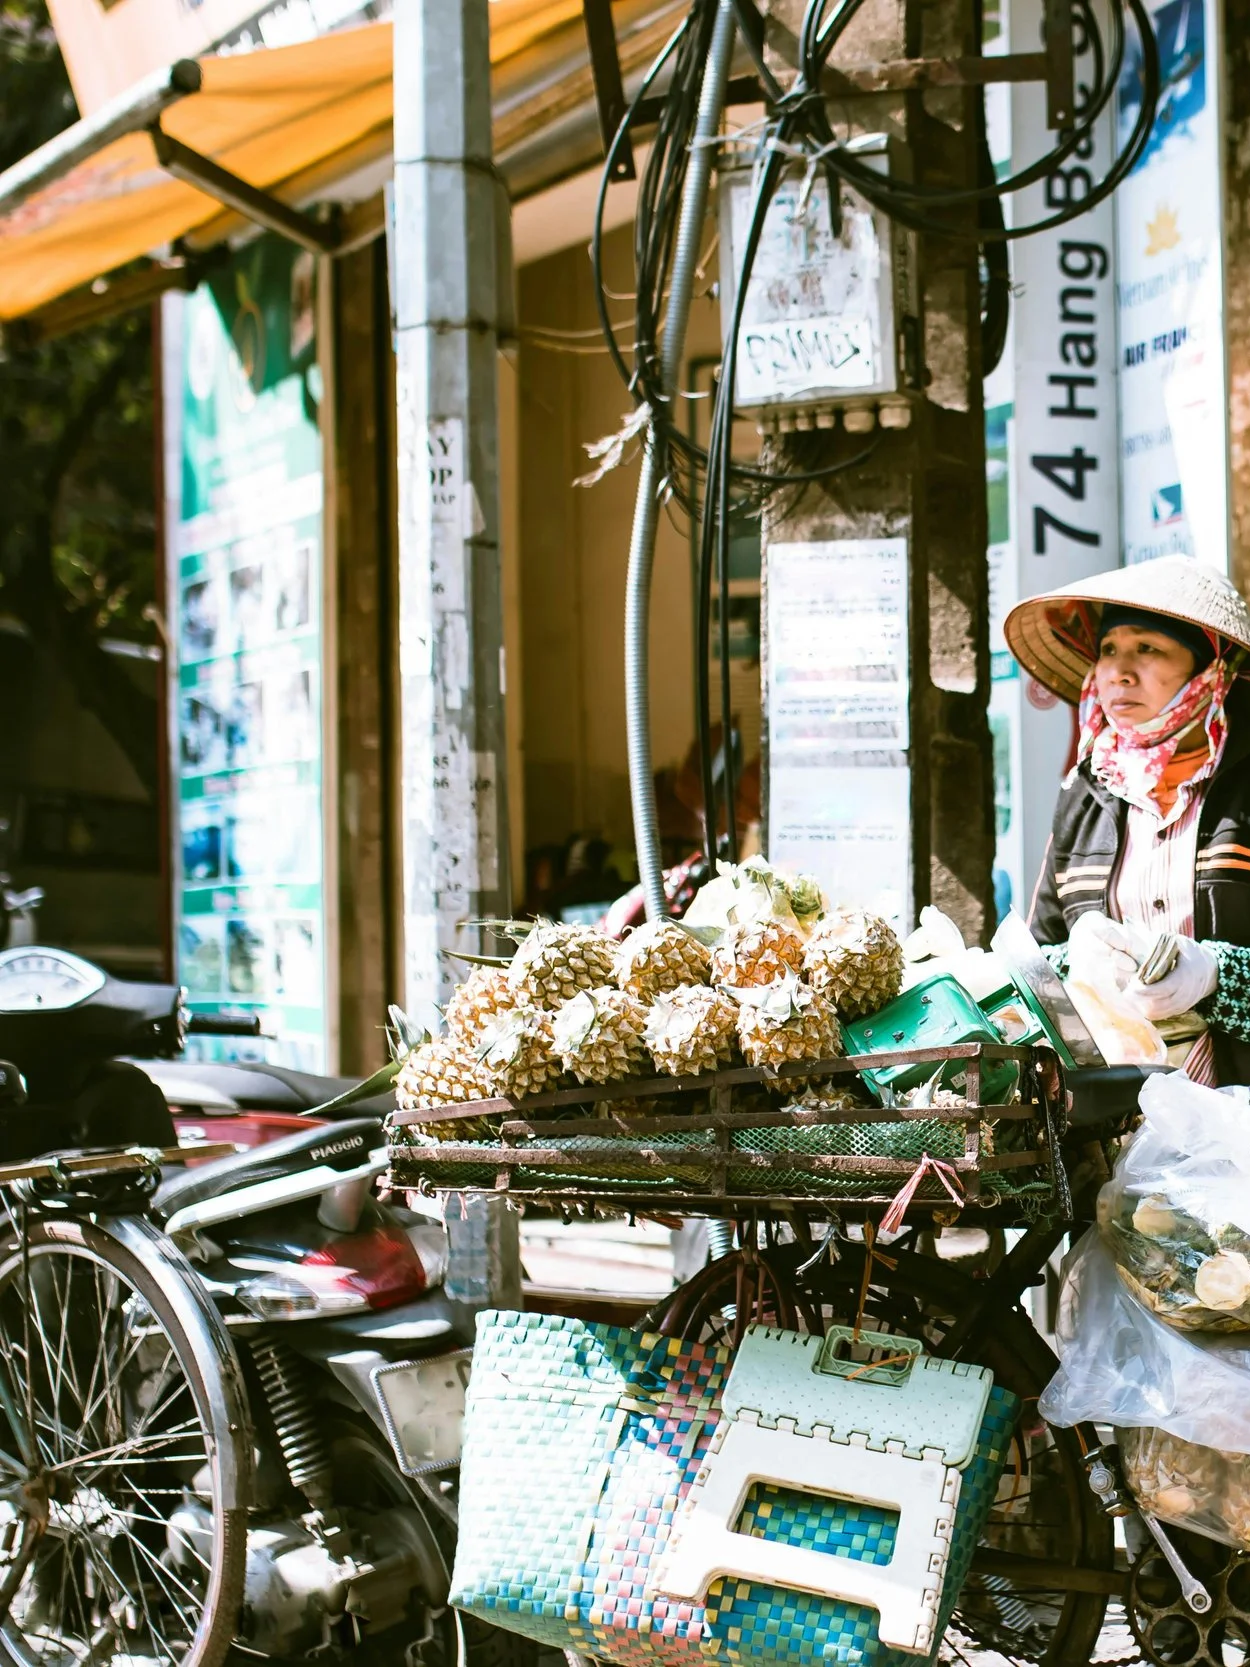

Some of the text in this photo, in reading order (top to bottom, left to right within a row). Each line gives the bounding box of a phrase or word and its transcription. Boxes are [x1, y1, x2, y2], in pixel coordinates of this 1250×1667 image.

[1047, 240, 1109, 419] Hang
[1031, 447, 1102, 555] 74
[310, 1135, 364, 1161] PIAGGIO
